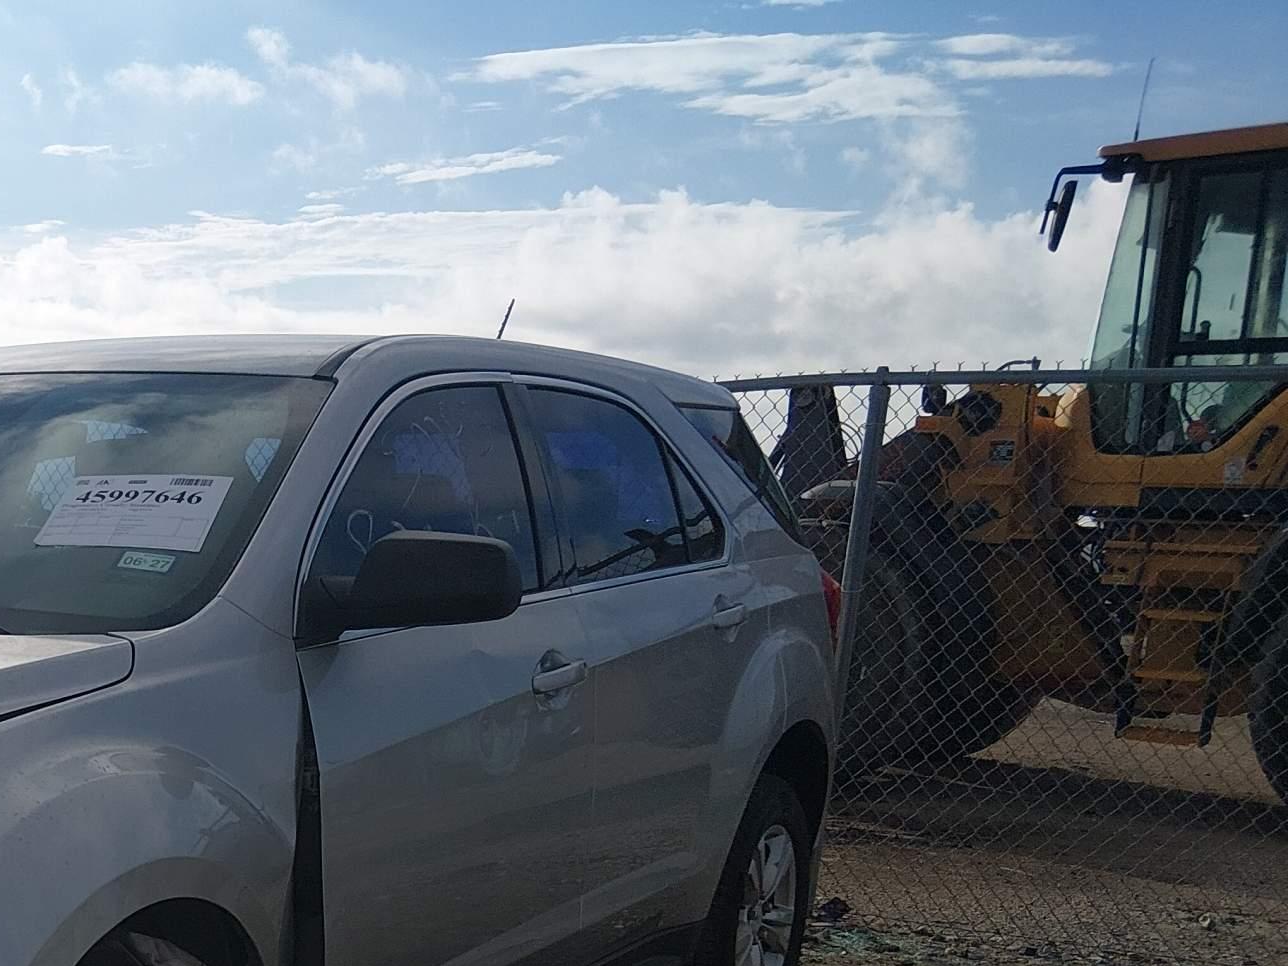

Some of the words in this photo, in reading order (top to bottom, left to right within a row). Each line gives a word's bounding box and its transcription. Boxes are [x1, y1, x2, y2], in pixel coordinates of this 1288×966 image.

[75, 489, 203, 505] 45997646
[123, 556, 143, 566] 06
[149, 559, 170, 569] 27
